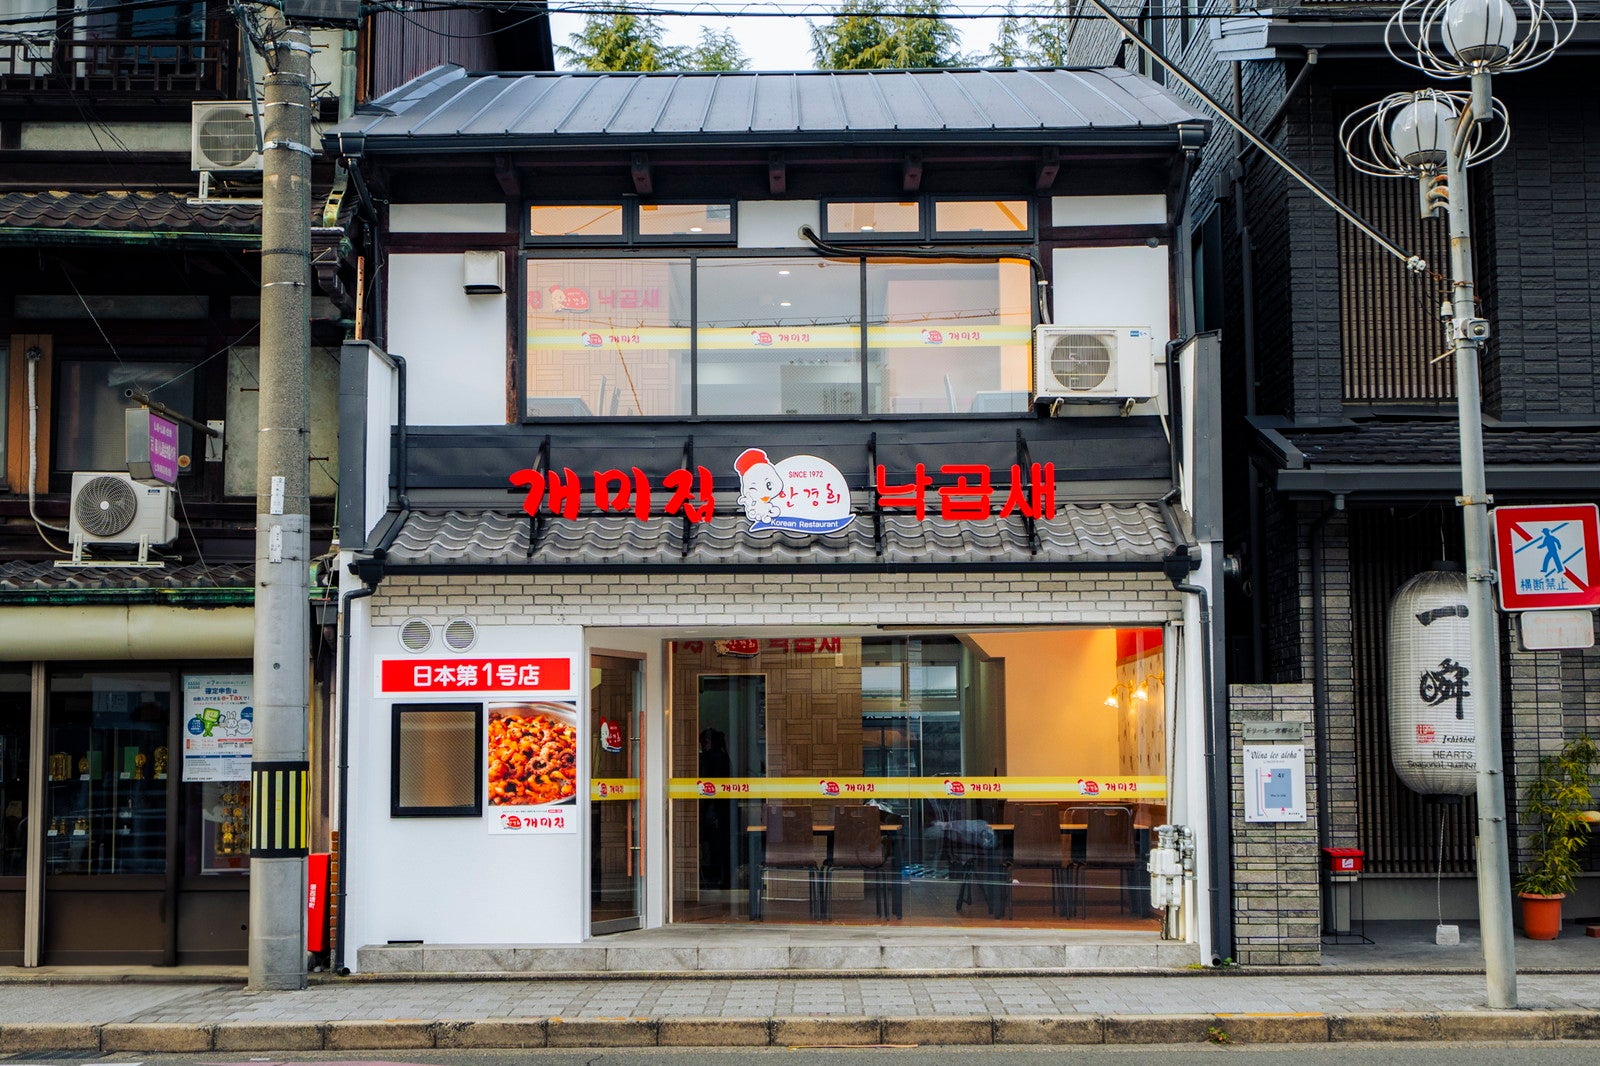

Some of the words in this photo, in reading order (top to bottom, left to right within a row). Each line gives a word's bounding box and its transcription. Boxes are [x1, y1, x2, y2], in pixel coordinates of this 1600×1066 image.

[788, 470, 807, 478] SINCE
[809, 470, 824, 478] 1972
[509, 465, 715, 523] 개미집
[779, 483, 841, 508] 안경희
[876, 462, 1056, 522] 낙곱새
[771, 519, 797, 528] Korean
[1521, 577, 1569, 591] 横断禁止
[413, 662, 540, 687] 日本第1号店
[1432, 750, 1473, 759] HEARTS
[721, 784, 750, 793] 개미집
[845, 783, 875, 793] 개미집
[970, 783, 1001, 792] 개미집
[1105, 783, 1137, 792] 개미집
[523, 817, 565, 829] 개미집
